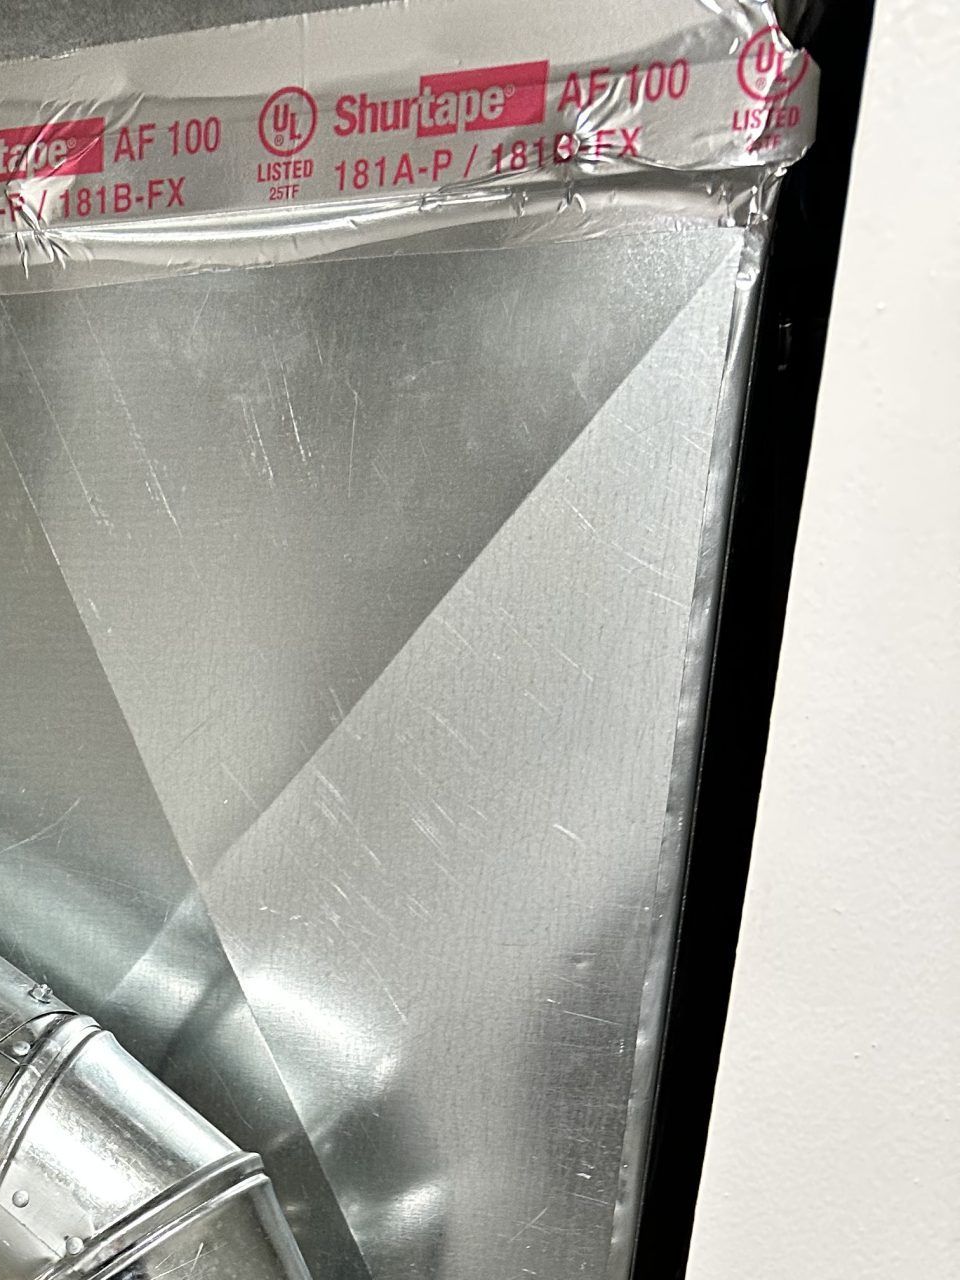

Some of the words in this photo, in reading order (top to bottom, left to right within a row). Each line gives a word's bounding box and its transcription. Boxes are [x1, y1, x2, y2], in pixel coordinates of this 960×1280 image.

[557, 67, 610, 113] AF
[626, 57, 688, 105] 100
[113, 123, 156, 163] AF
[168, 116, 222, 157] 100
[732, 105, 800, 131] LISTED
[256, 158, 314, 183] LISTED
[334, 148, 453, 191] 181A-P
[59, 176, 186, 219] 181B-FX
[268, 184, 300, 201] 25TF
